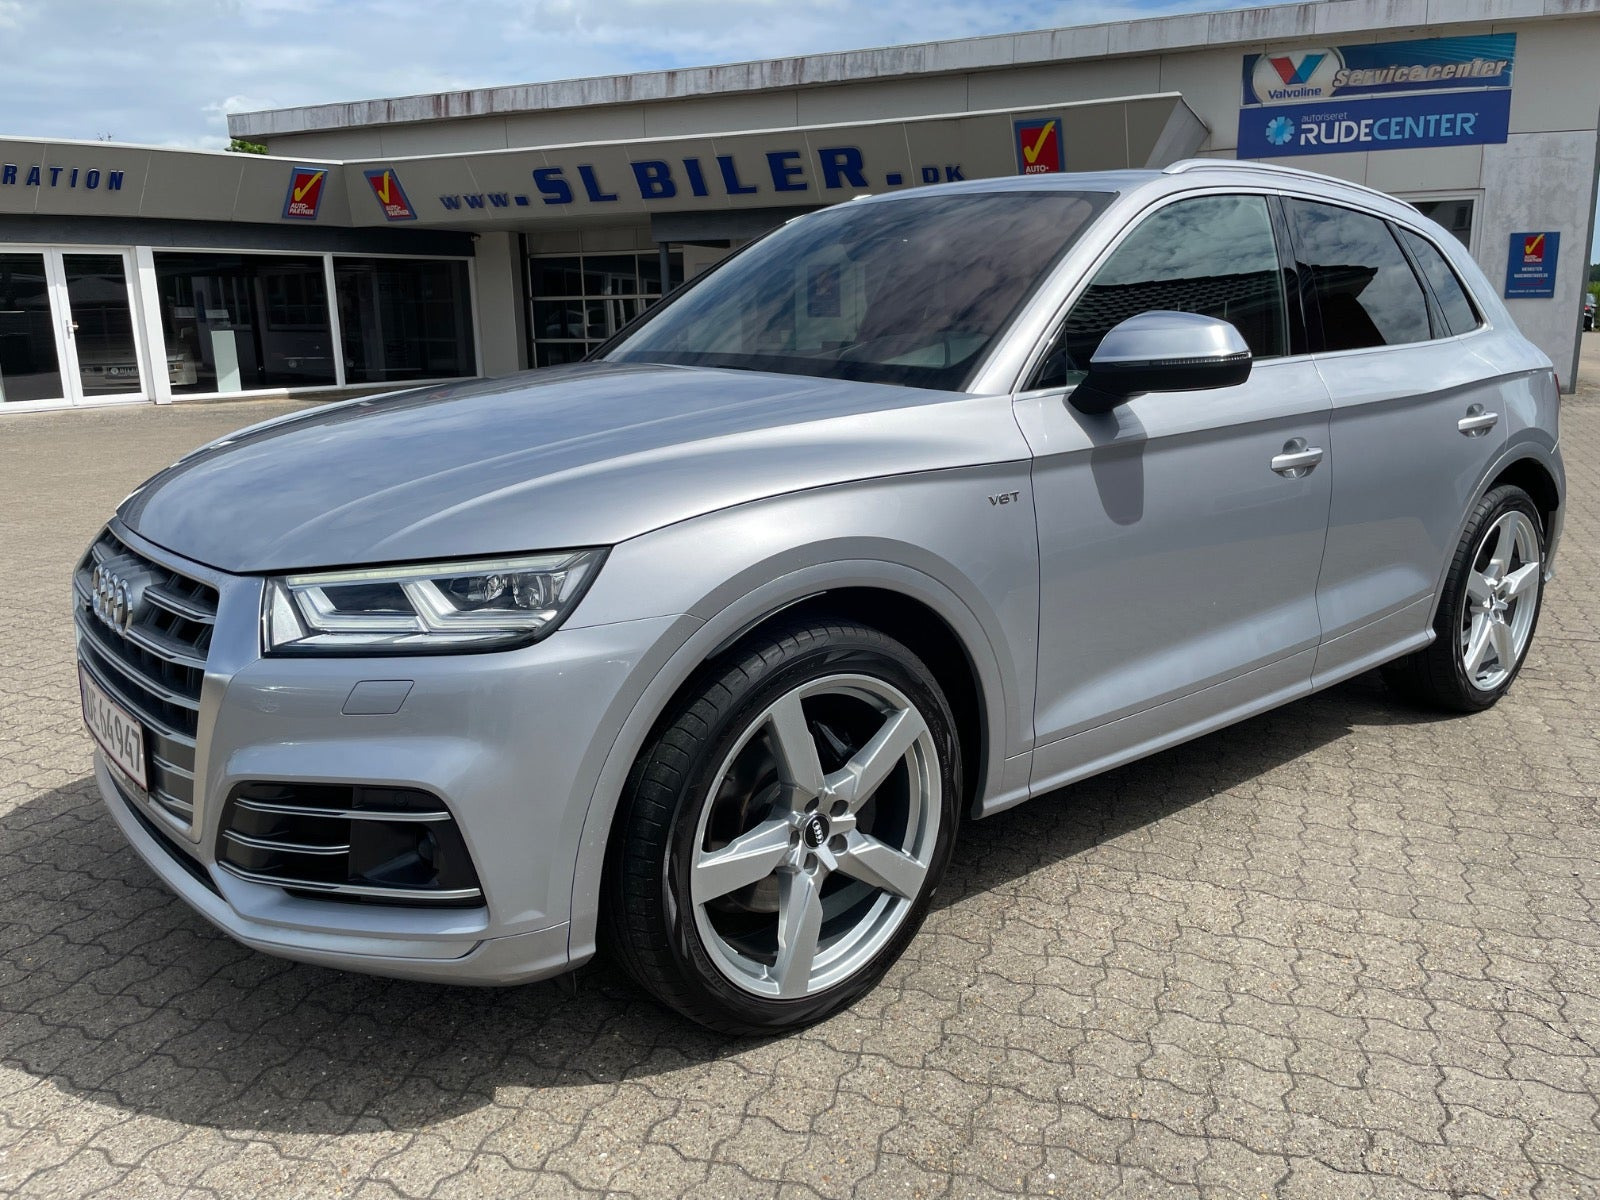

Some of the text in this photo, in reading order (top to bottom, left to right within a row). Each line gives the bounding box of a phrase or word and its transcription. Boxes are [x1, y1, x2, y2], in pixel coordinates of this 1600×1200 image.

[1268, 87, 1322, 99] Valvoline
[1301, 112, 1348, 122] autoriseret
[1300, 113, 1477, 146] RUDECENTER
[1025, 164, 1049, 173] AUTO-
[2, 163, 125, 191] RATION
[288, 208, 314, 216] PARTNER
